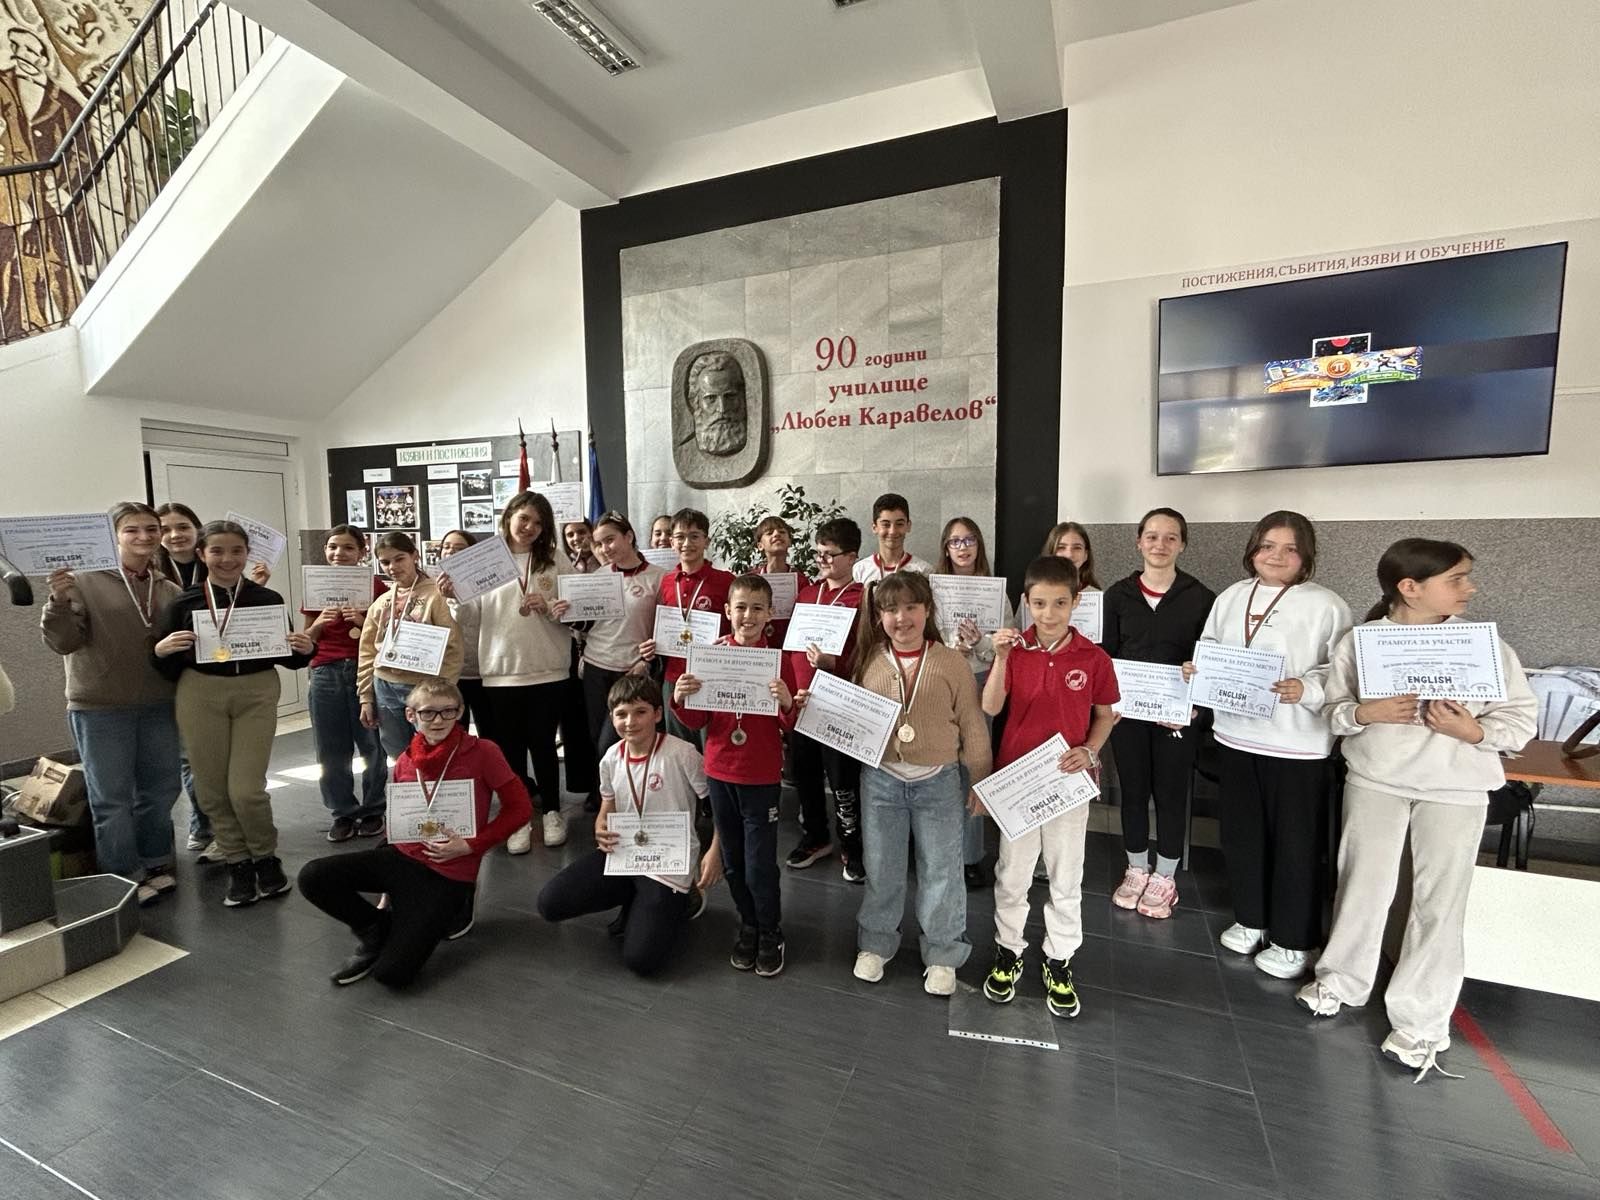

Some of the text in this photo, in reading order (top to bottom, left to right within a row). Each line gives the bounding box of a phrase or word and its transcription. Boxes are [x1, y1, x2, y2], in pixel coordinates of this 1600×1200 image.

[1405, 250, 1415, 262] И
[1420, 238, 1506, 259] ОБУЧЕНИЕ
[815, 335, 927, 371] 90 години
[828, 377, 929, 403] училище
[45, 554, 82, 563] ENGLISH
[1432, 638, 1473, 646] УЧАСТИЕ
[1407, 675, 1453, 684] ENGLISH
[717, 691, 747, 700] ENGLISH
[1218, 689, 1248, 701] ENGLISH
[1134, 700, 1163, 709] ENGLISH
[827, 723, 855, 741] ENGLISH
[1029, 792, 1061, 814] ENGLISH
[635, 854, 661, 862] ENGLISH
